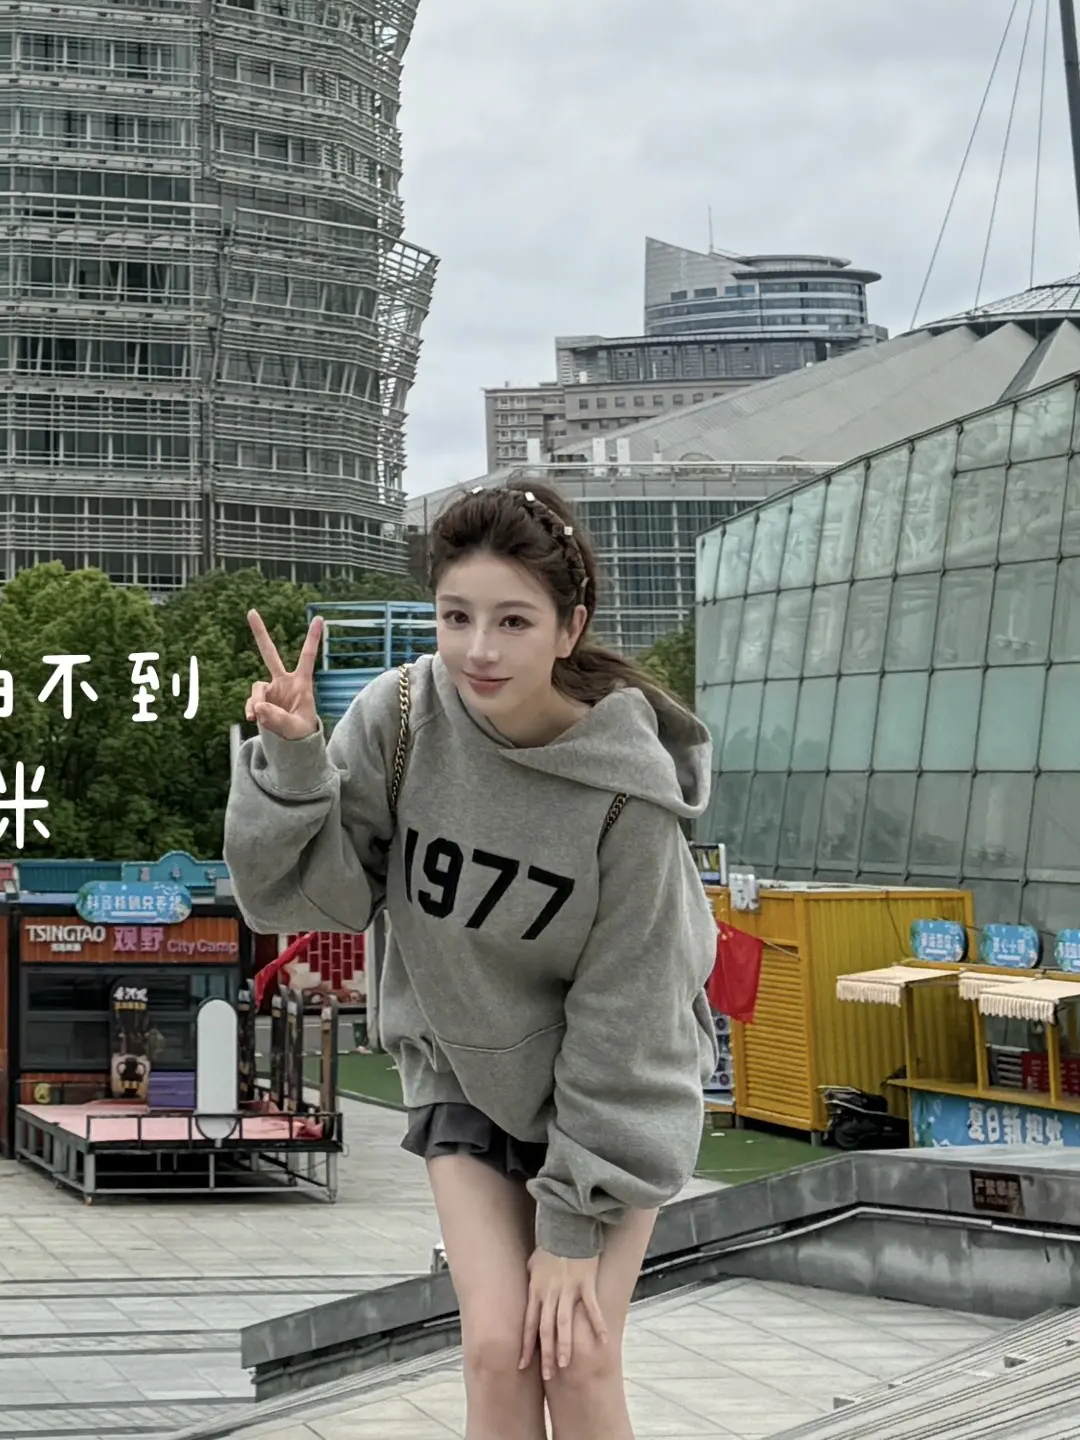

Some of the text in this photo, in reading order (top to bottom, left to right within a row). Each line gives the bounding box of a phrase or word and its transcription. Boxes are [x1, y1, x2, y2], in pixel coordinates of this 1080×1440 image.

[404, 827, 575, 940] 1977
[25, 925, 106, 942] TSINGTAO
[167, 940, 238, 954] City Camp
